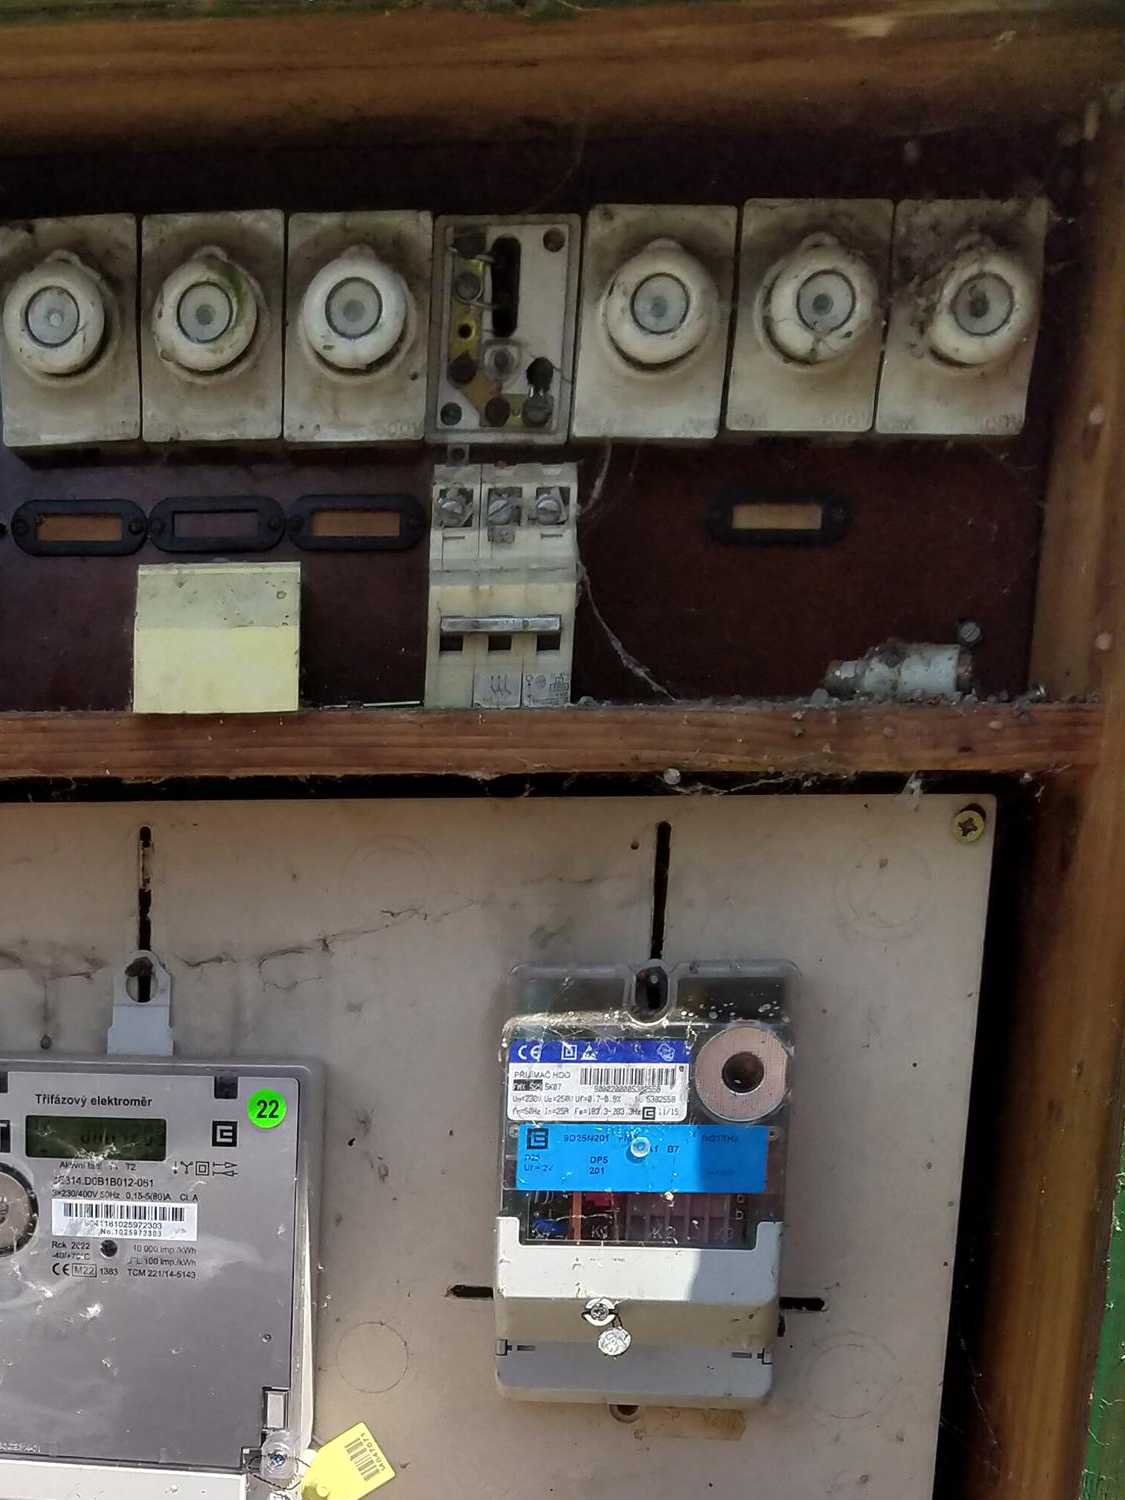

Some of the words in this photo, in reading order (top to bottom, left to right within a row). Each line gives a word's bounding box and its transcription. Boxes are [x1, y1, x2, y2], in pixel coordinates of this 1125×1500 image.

[552, 1071, 571, 1079] HDO
[90, 1096, 153, 1107] elektroměr
[256, 1099, 280, 1119] 22
[666, 1145, 679, 1153] B7
[126, 1162, 136, 1171] T2
[588, 1166, 605, 1175] 201
[99, 1191, 120, 1200] 50Hz
[74, 1265, 95, 1276] M22
[127, 1268, 146, 1277] TCM
